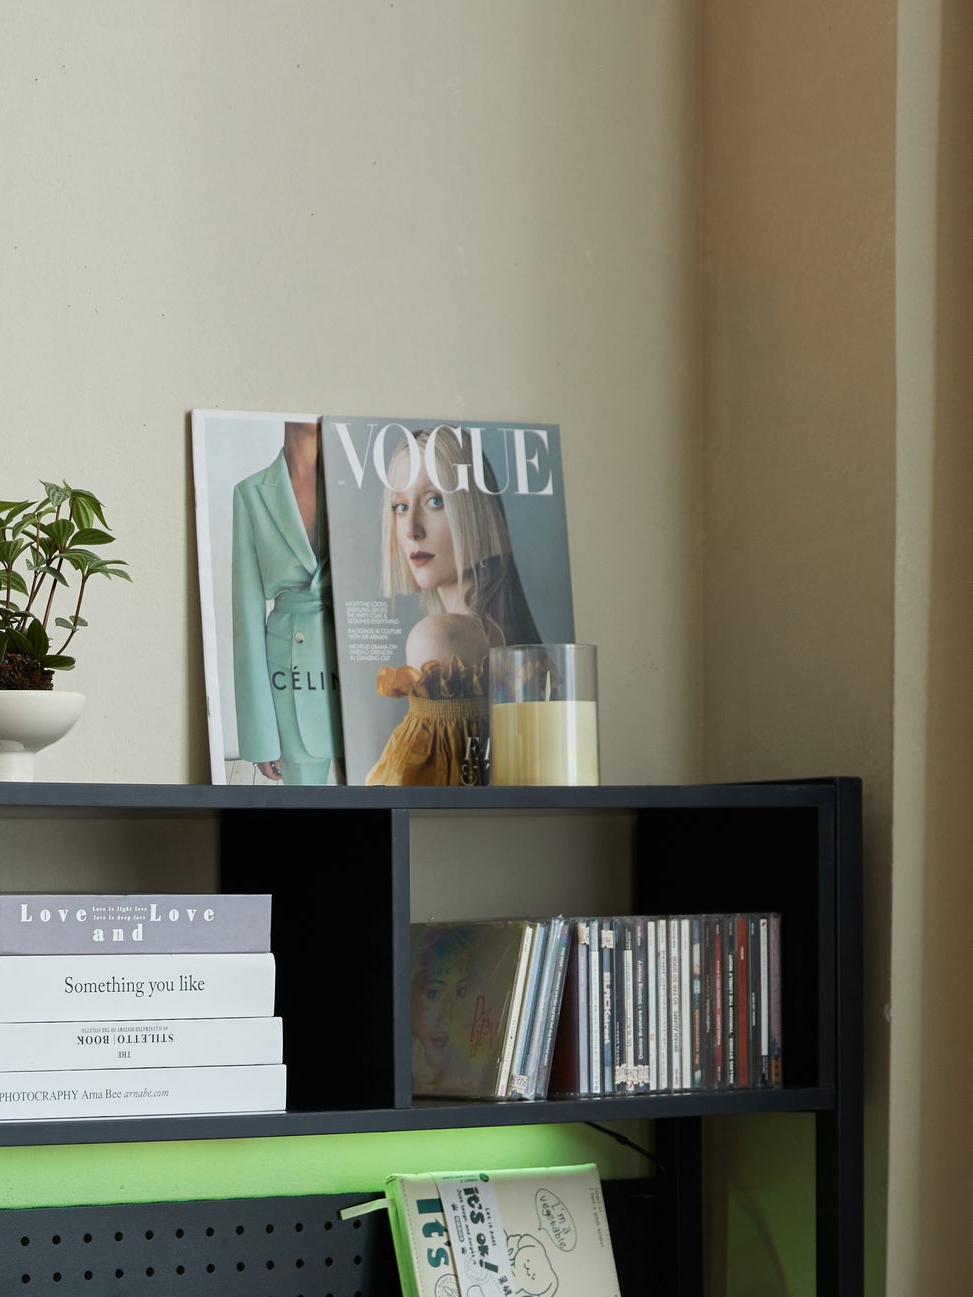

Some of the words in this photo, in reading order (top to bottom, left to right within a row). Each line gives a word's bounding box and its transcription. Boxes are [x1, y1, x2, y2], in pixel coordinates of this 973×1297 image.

[331, 421, 554, 496] VOGUE
[20, 903, 87, 923] Love
[149, 903, 215, 922] Love
[92, 923, 143, 941] and
[64, 976, 145, 997] Something
[148, 980, 174, 997] you
[179, 975, 205, 992] like
[77, 1035, 109, 1045] BOOK
[117, 1033, 174, 1044] STILETTO
[117, 1051, 131, 1059] THE
[105, 1088, 122, 1099] Bee
[540, 1195, 567, 1249] vegetable
[416, 1198, 452, 1268] It's
